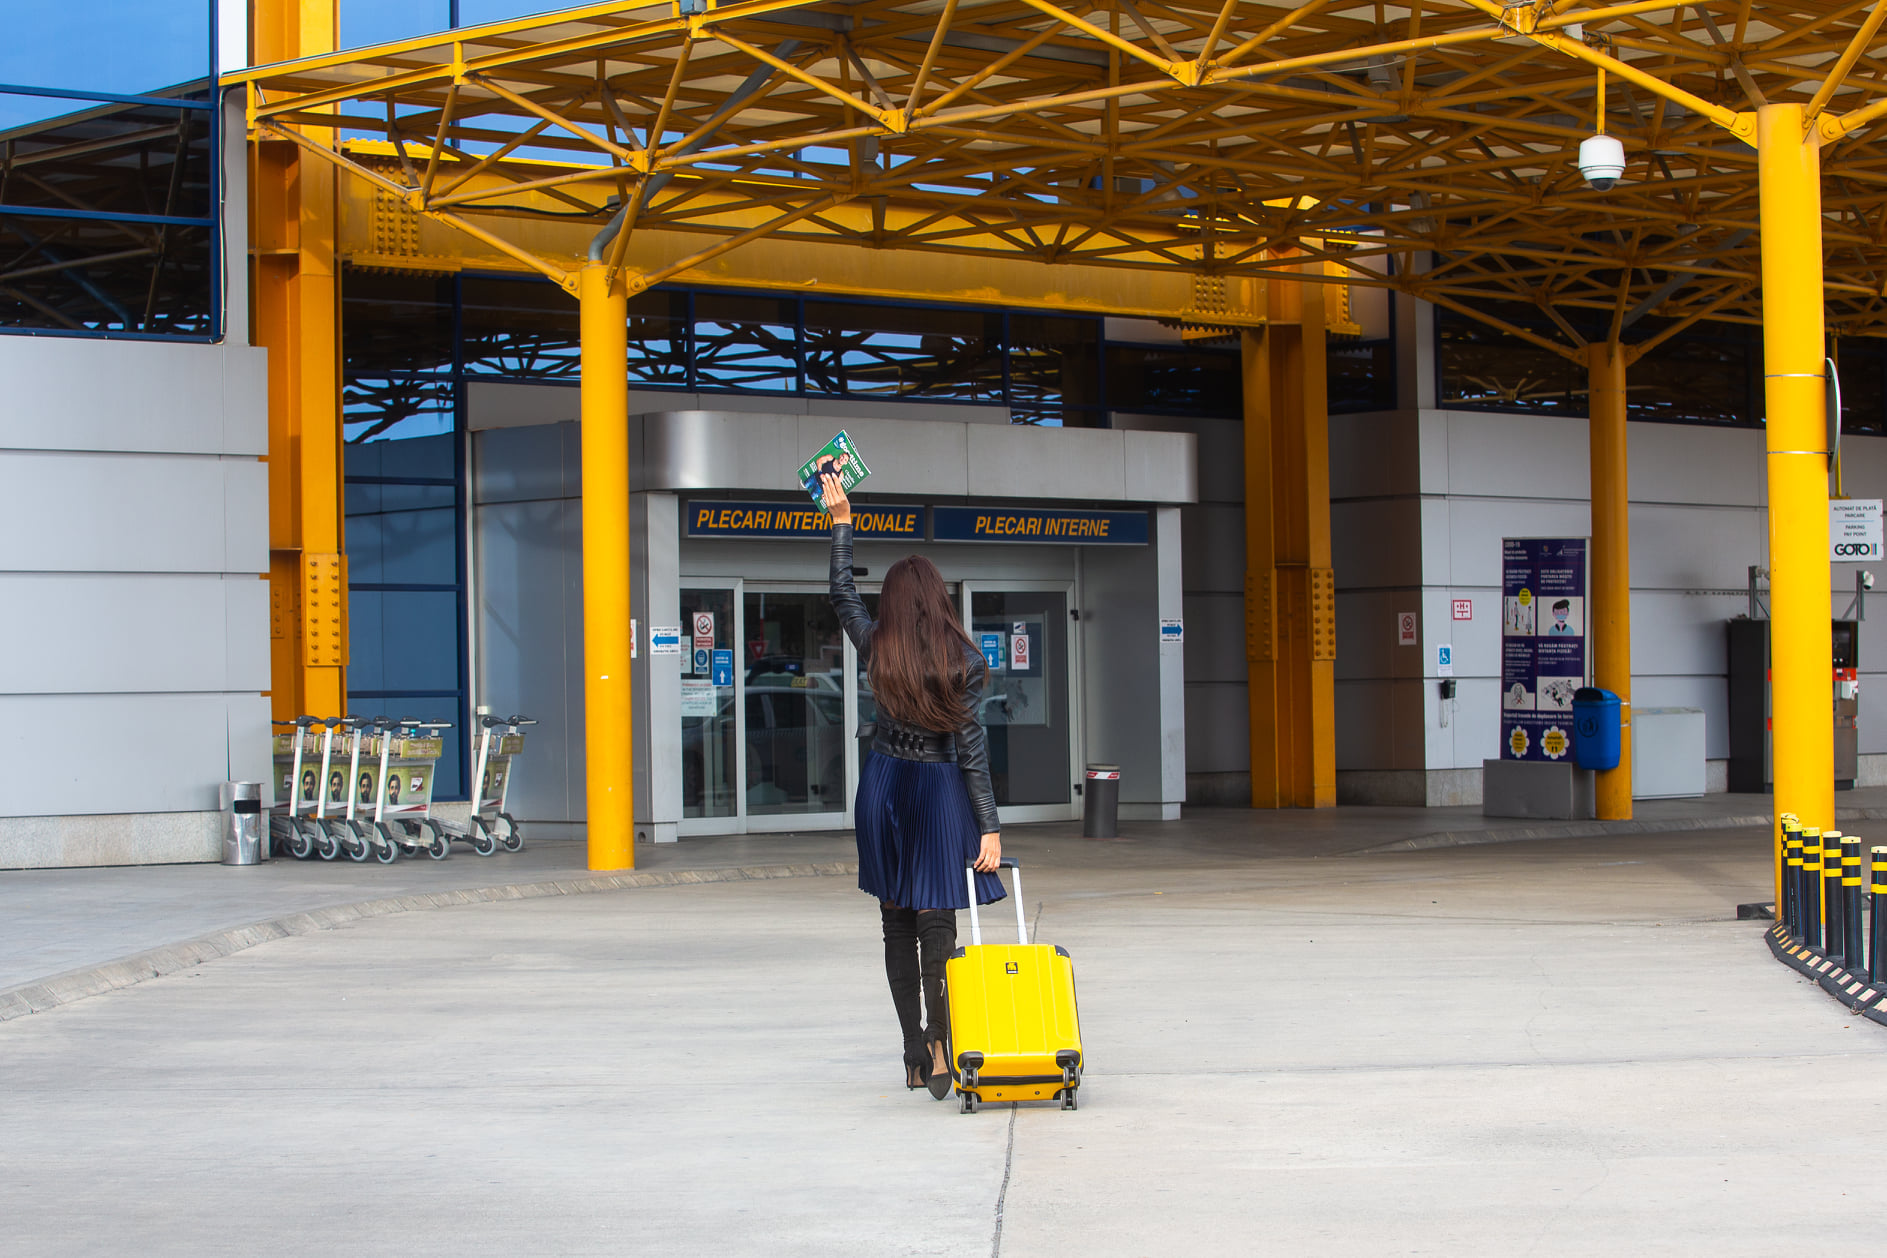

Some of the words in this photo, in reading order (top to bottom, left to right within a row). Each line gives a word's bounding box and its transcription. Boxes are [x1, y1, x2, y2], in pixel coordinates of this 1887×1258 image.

[696, 509, 772, 529] PLECARI
[774, 511, 917, 533] INTERNTIONALE
[975, 516, 1043, 536] PLECARI
[1044, 518, 1110, 537] INTERNE
[1834, 543, 1870, 556] GOTO
